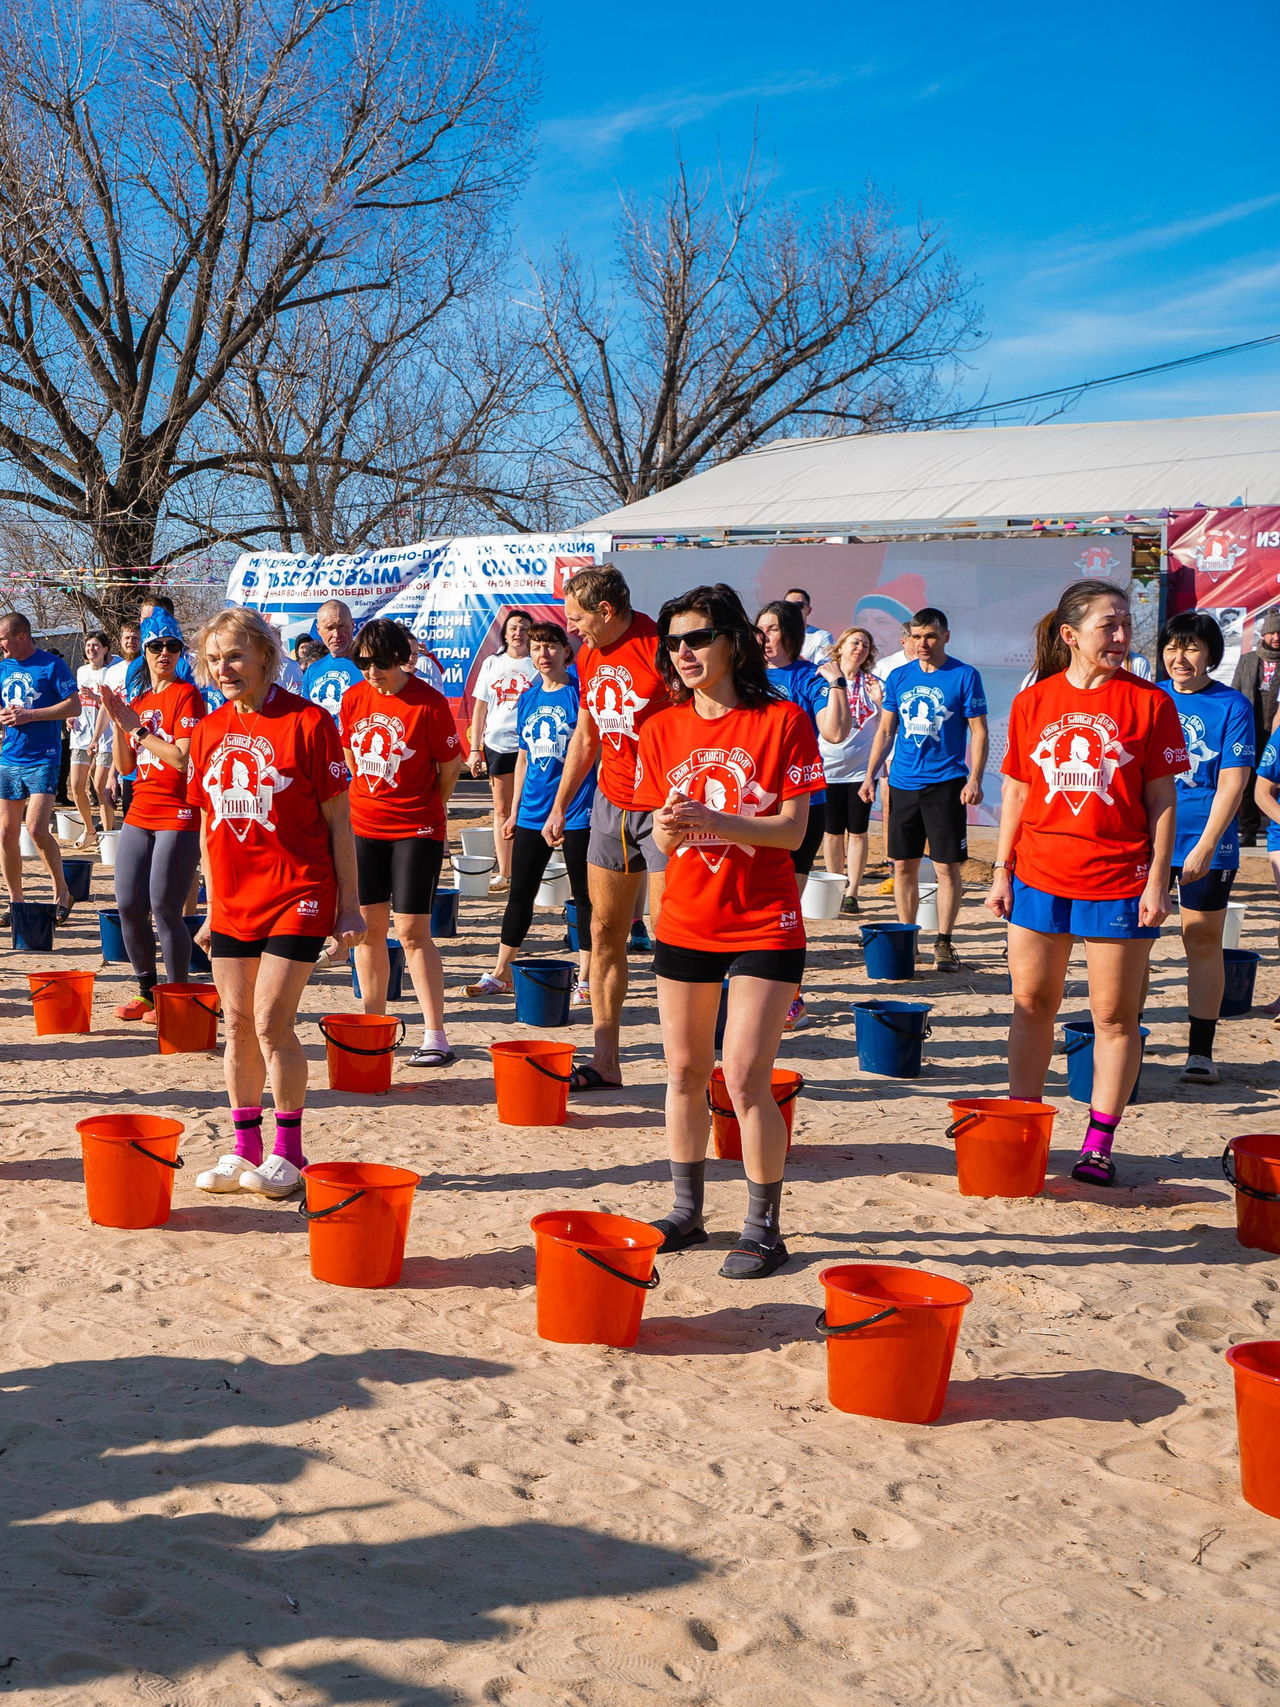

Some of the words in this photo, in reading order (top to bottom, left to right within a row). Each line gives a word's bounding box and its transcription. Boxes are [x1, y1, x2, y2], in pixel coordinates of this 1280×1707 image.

[331, 588, 374, 597] ПОБЕДЫ
[513, 578, 547, 588] ВОЙНЕ
[415, 627, 454, 641] ОДОЙ
[1067, 714, 1092, 726] СЛАВА
[1097, 716, 1116, 732] ДОЛГ
[697, 750, 725, 764] СЛАВА
[731, 748, 752, 770] ДОЛГ
[803, 764, 822, 775] ПУТ
[803, 773, 824, 783] ДОМ
[779, 920, 798, 928] SPORT
